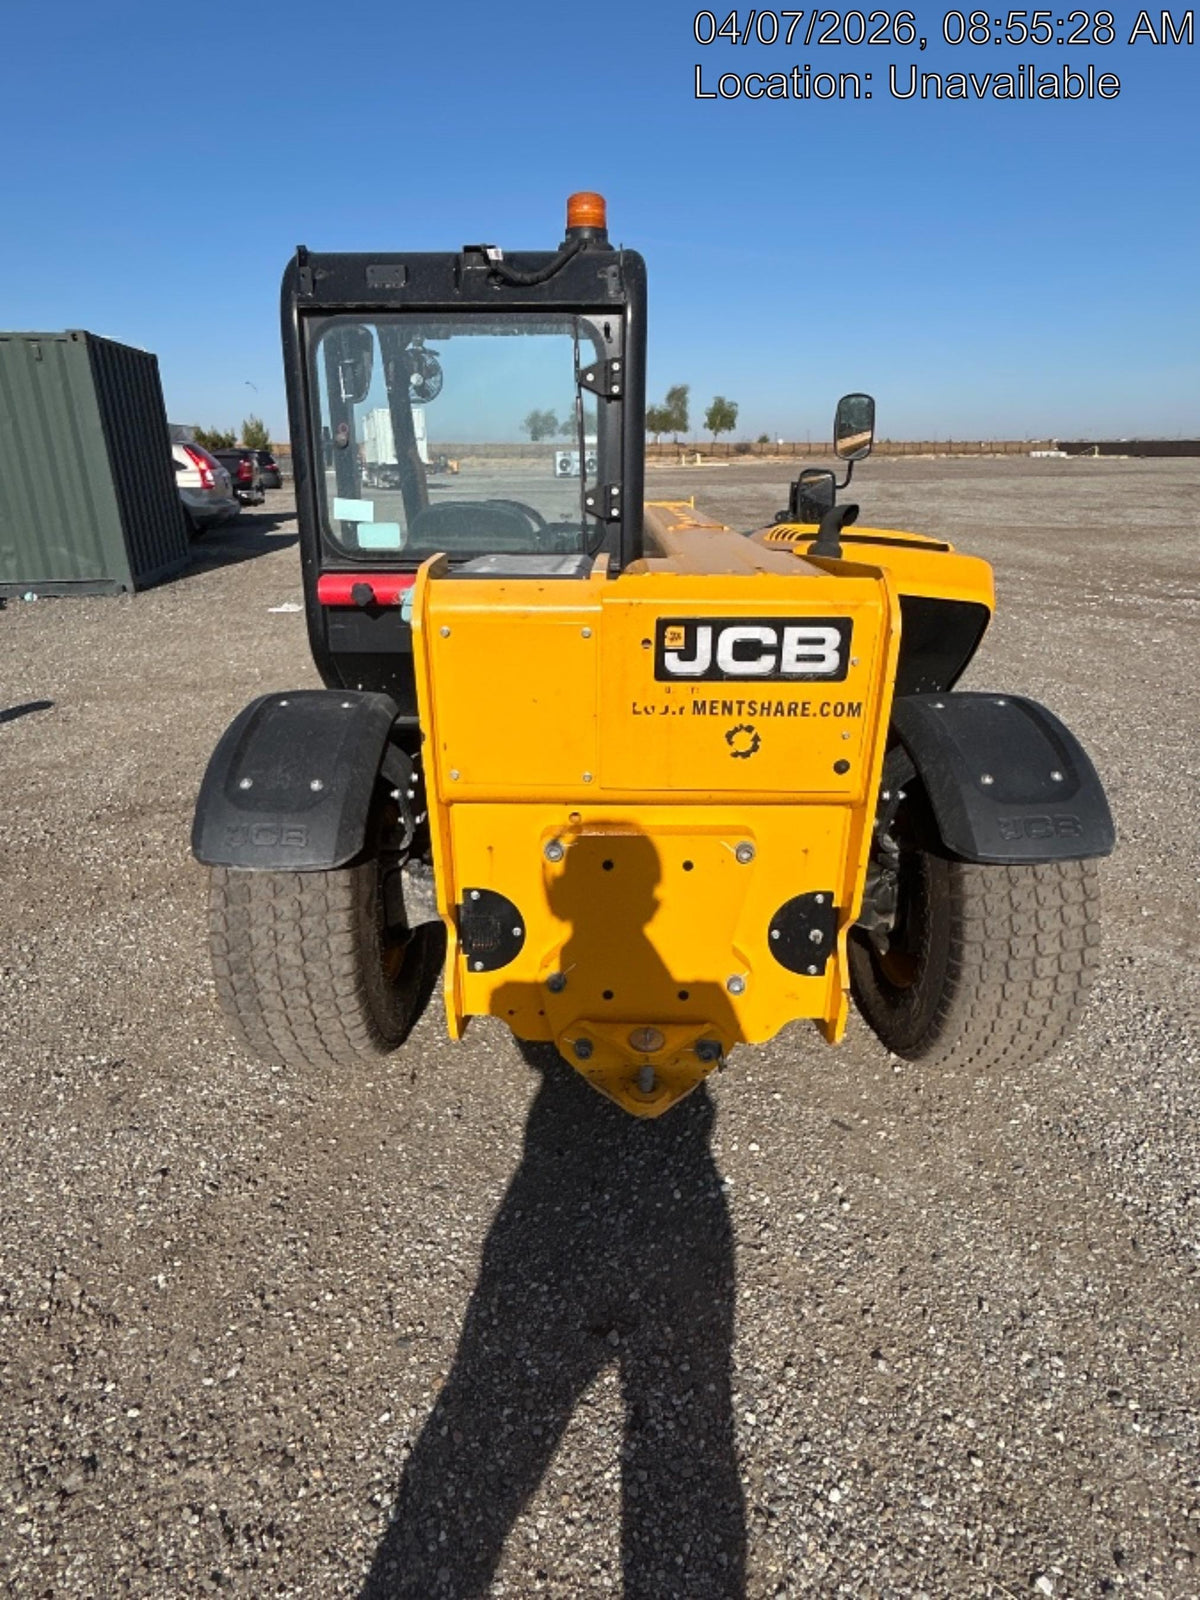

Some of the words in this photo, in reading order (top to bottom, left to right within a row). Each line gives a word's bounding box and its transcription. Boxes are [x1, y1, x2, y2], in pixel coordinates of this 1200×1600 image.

[664, 625, 841, 675] JCB
[632, 700, 862, 717] MENTSHARE.COM
[226, 822, 310, 848] JCB
